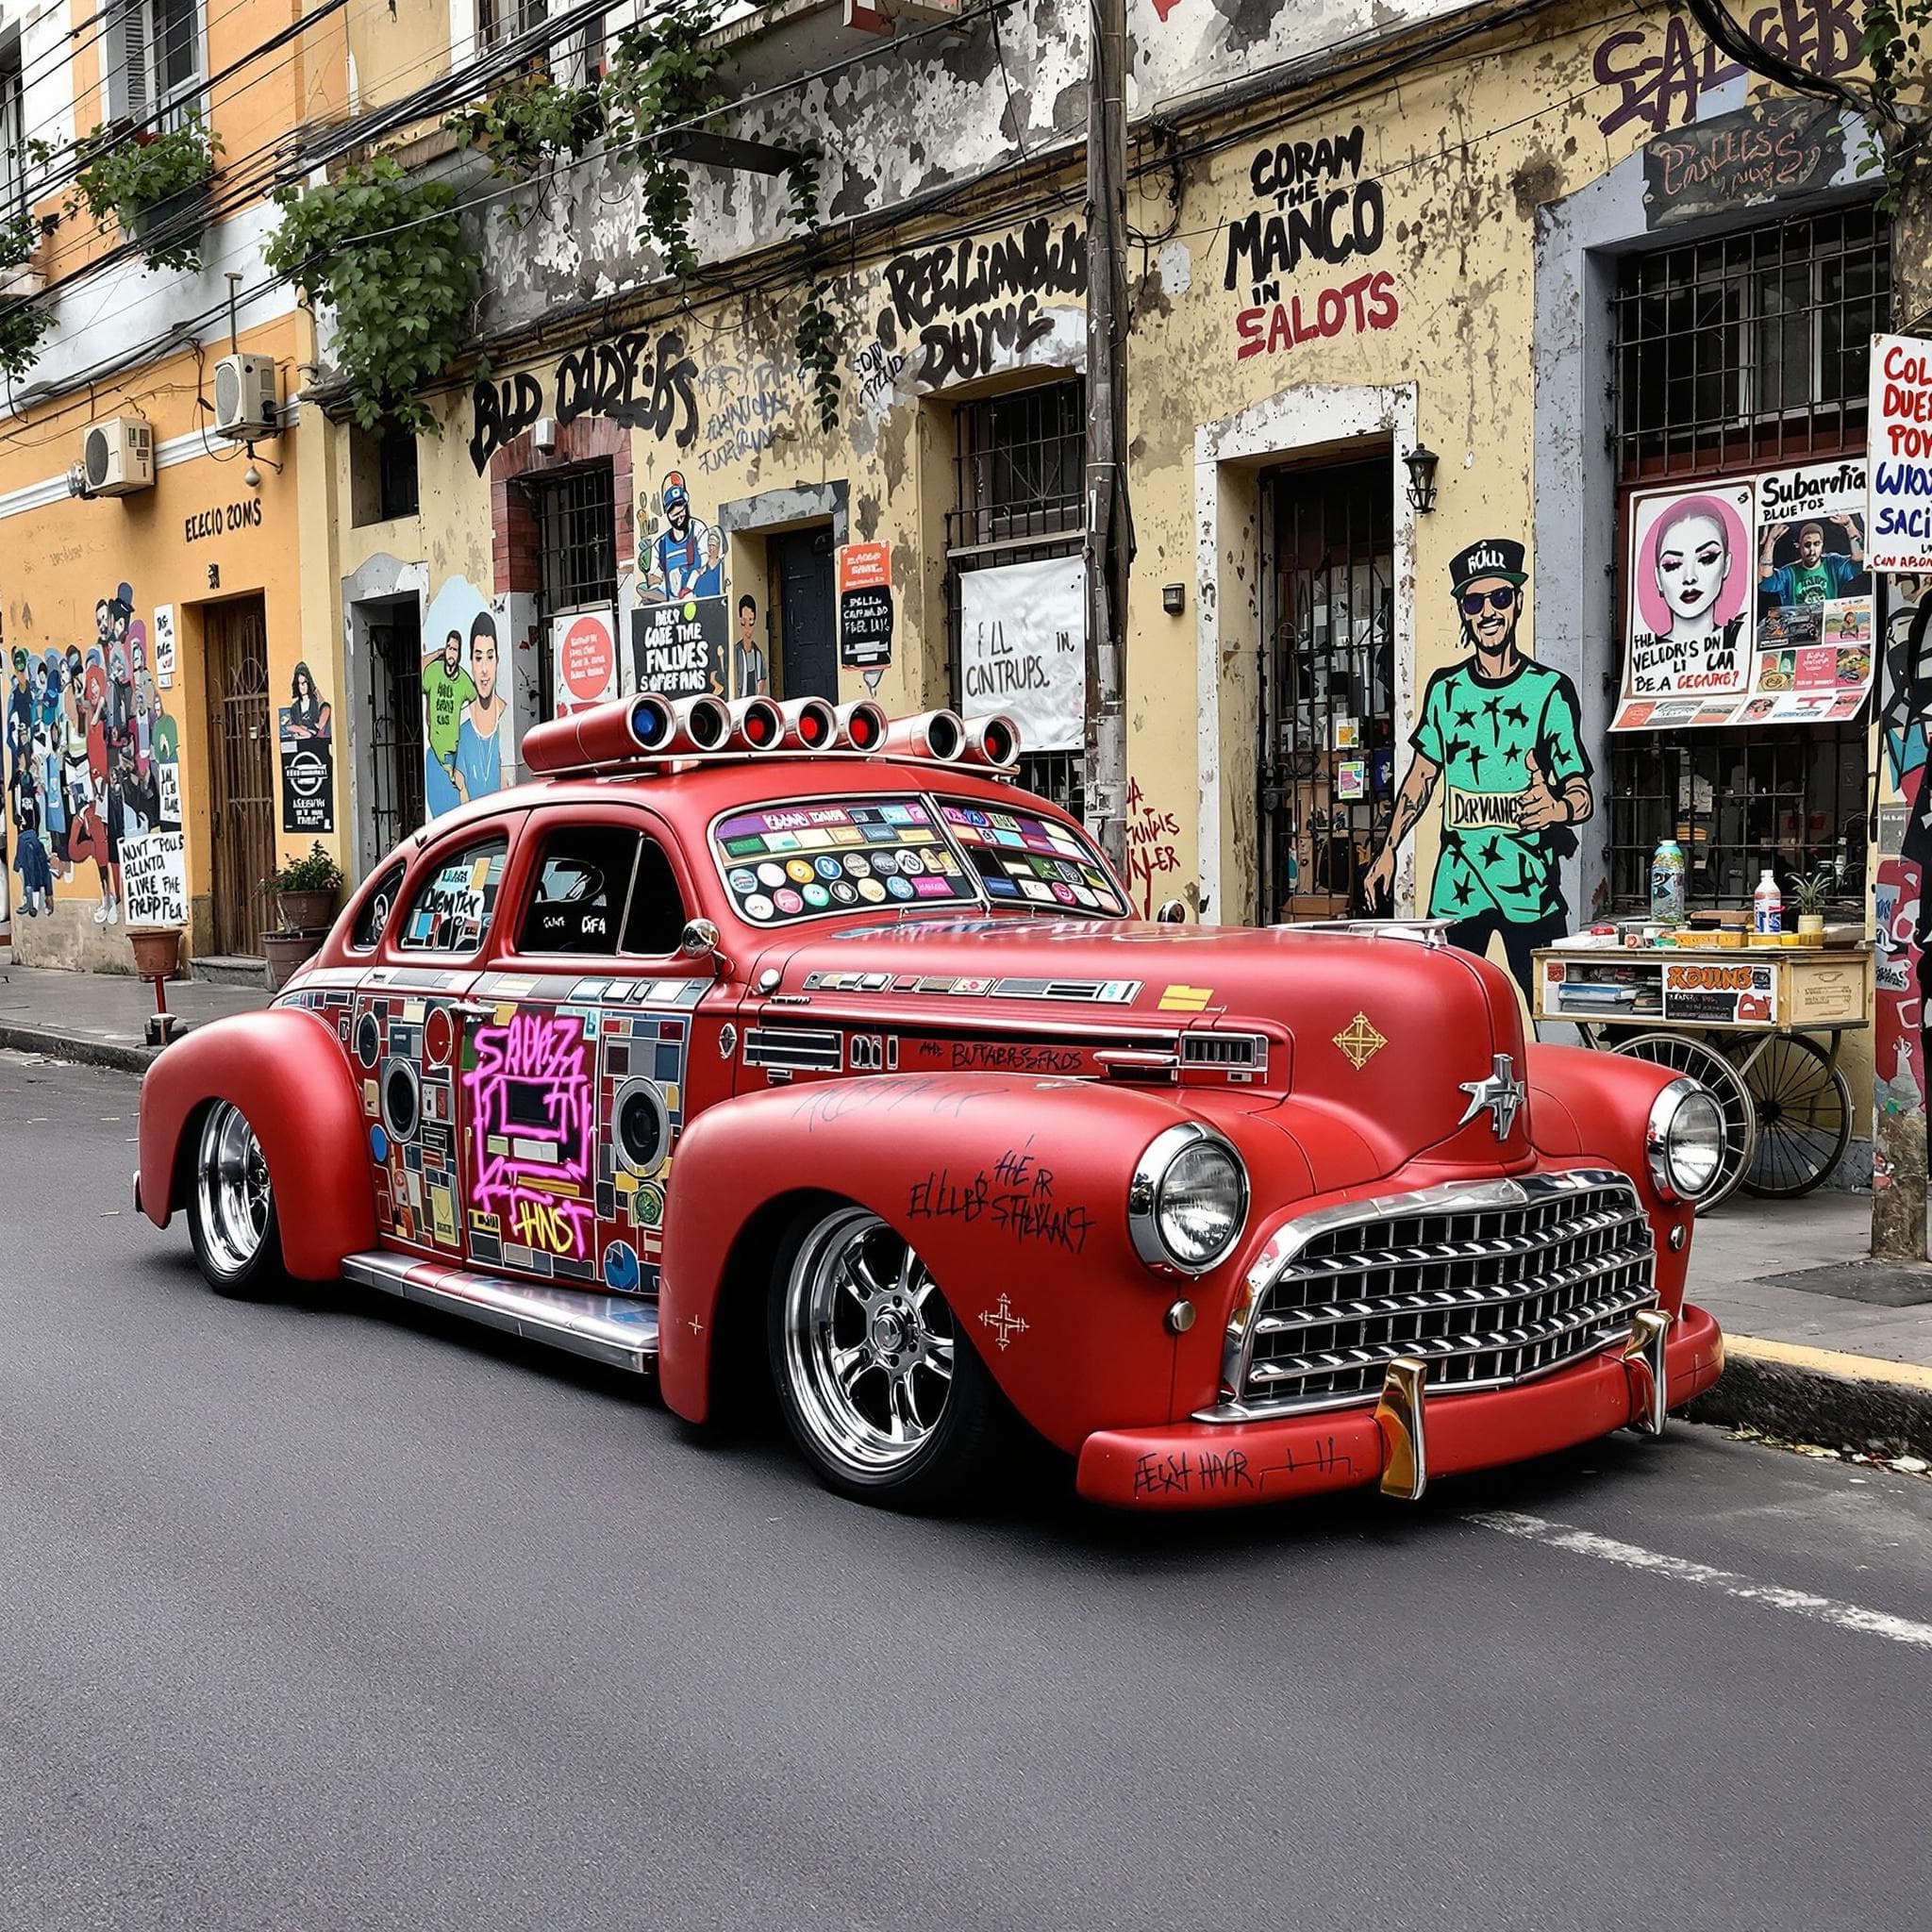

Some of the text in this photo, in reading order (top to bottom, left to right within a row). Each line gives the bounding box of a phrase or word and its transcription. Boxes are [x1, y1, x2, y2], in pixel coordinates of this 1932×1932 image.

[1273, 179, 1319, 211] THE
[1224, 179, 1385, 291] MANCO
[1236, 271, 1399, 360] SALOTS
[1252, 280, 1281, 306] IN
